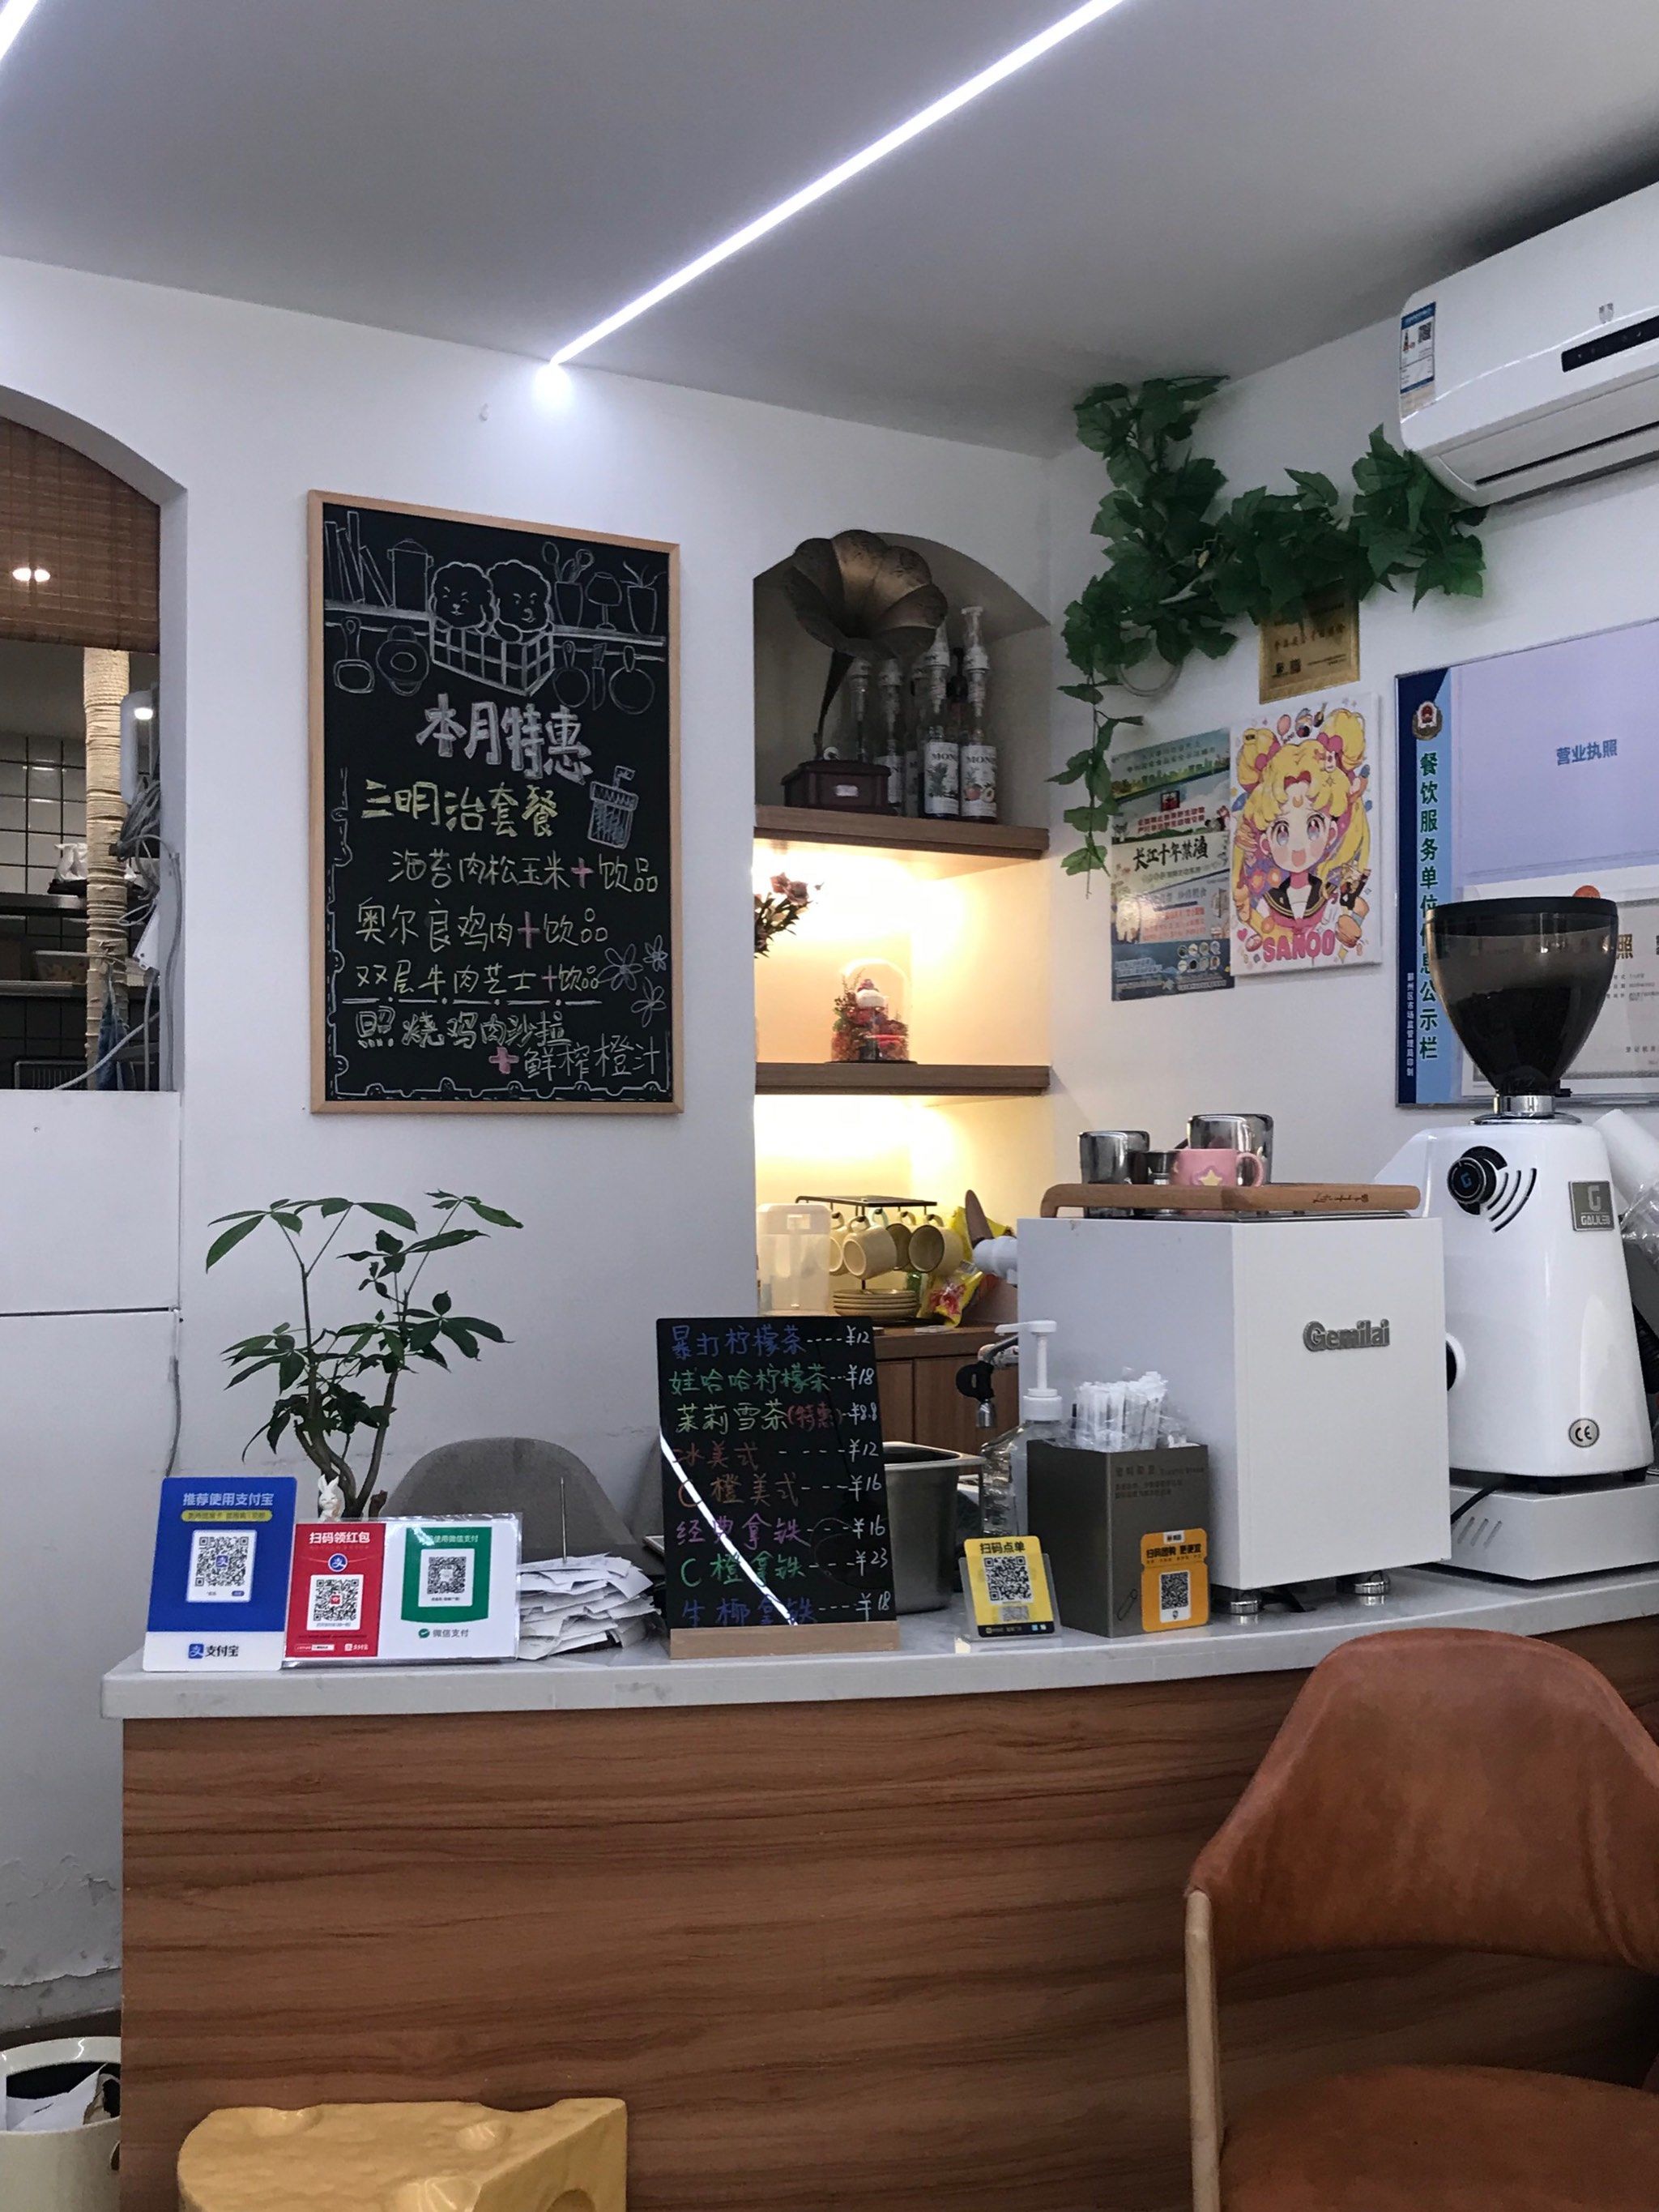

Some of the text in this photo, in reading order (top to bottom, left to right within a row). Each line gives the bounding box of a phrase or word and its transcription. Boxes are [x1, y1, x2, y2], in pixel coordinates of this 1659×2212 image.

[416, 694, 593, 784] 本月特惠
[1556, 739, 1618, 766] 营业执照
[361, 779, 558, 837] 三明治套餐
[1132, 835, 1209, 872] 长江十年禁渔
[356, 1006, 571, 1050] 照烧鸡肉沙拉
[672, 1324, 806, 1360] 暴打柠檬茶
[1303, 1319, 1390, 1352] Gemilai
[668, 1362, 831, 1396] 娃哈哈柠檬茶
[672, 1440, 758, 1471] 冰美式
[182, 1492, 274, 1506] 推荐使用支付宝
[309, 1531, 370, 1544] 扫码领红包
[419, 1535, 479, 1543] 使用微信支付
[979, 1542, 1025, 1554] 扫码点单
[433, 1629, 469, 1638] 微信支付
[205, 1645, 239, 1657] 支付宝
